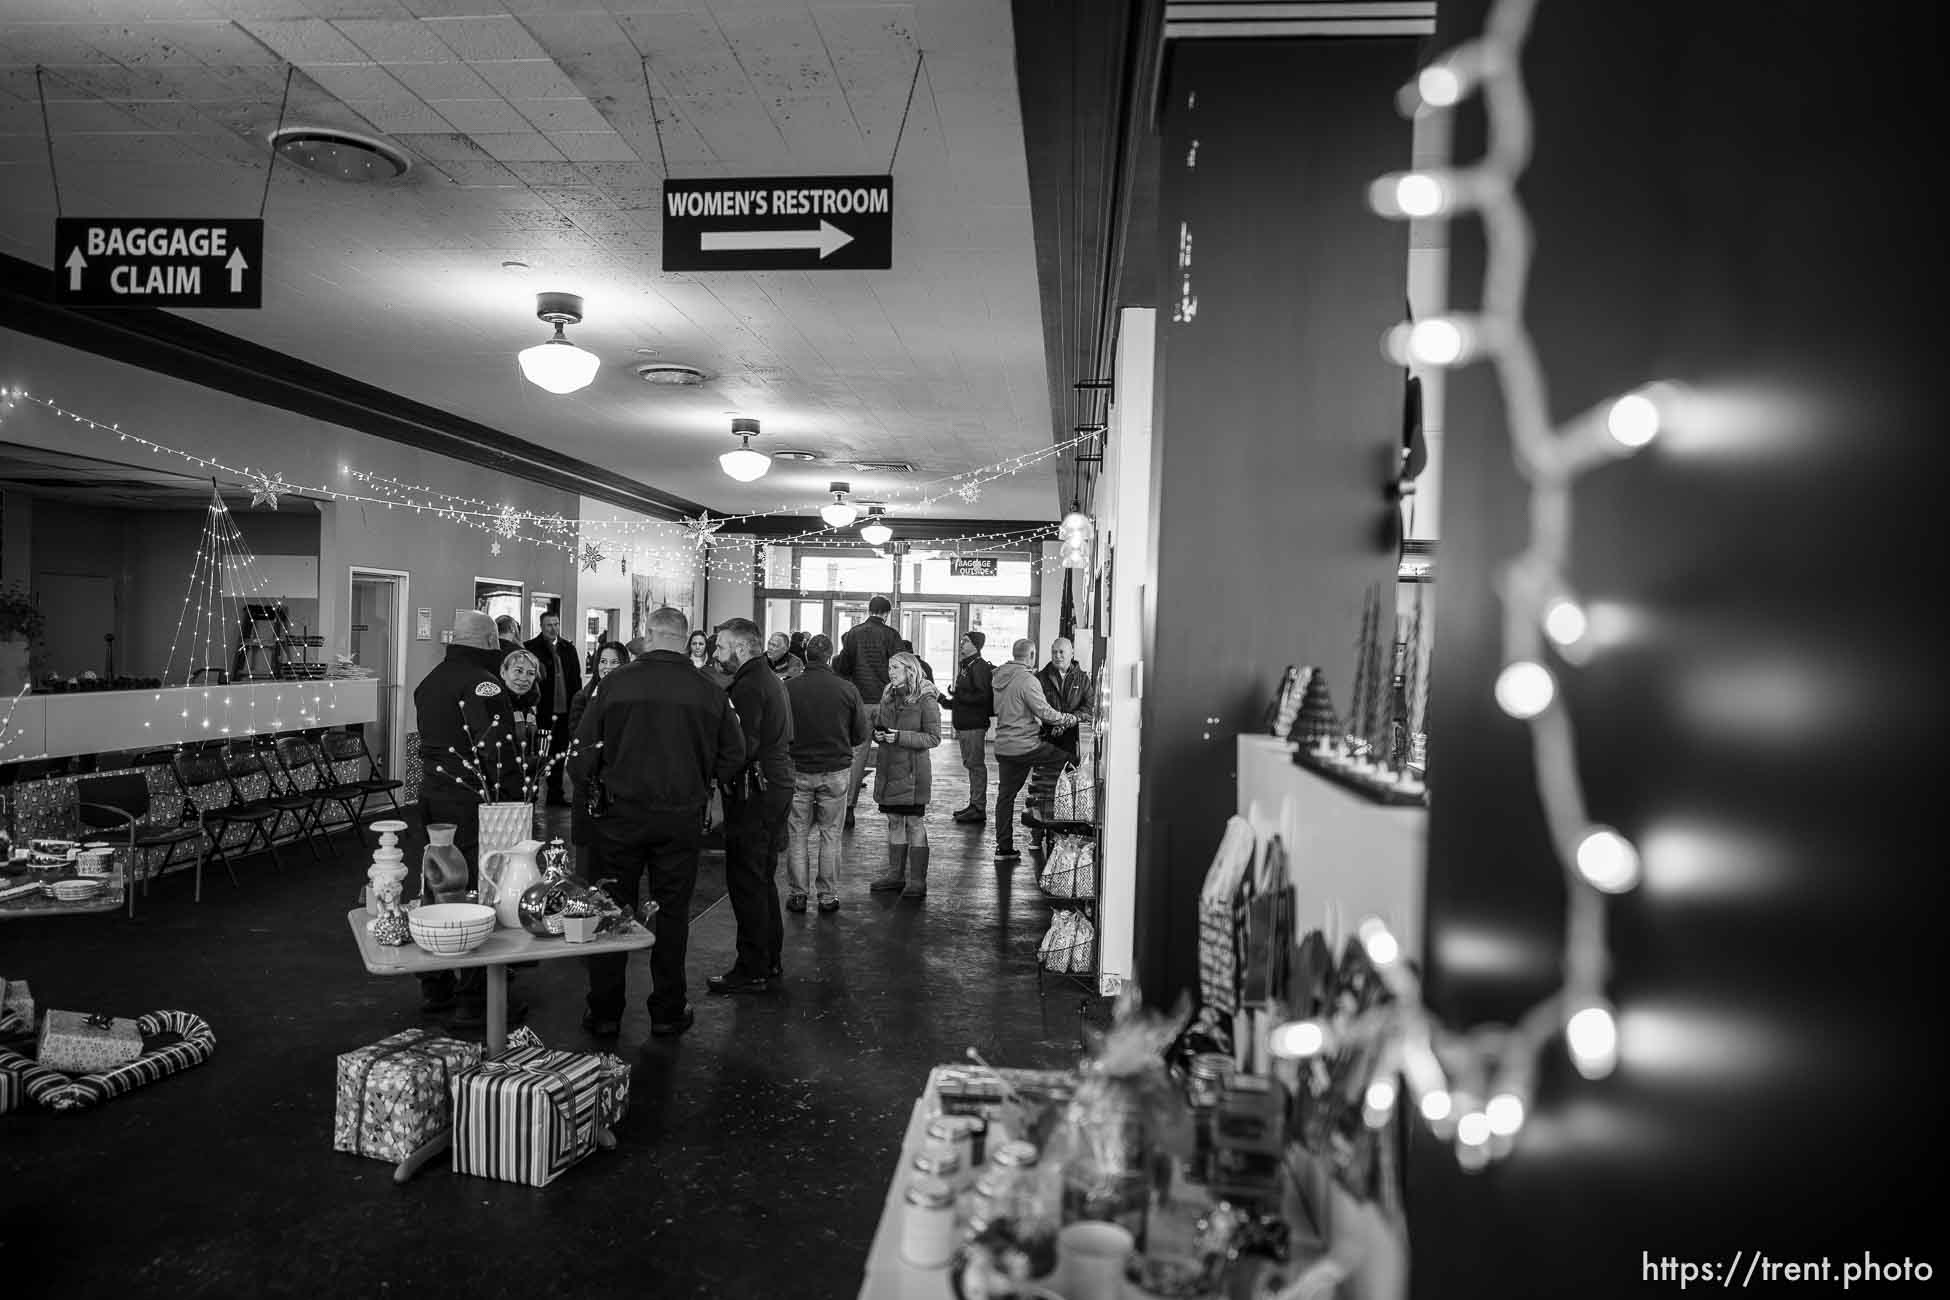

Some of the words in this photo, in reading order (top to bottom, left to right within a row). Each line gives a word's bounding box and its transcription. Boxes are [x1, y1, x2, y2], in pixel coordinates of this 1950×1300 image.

[668, 191, 768, 216] WOMEN’S
[773, 189, 888, 214] RESTROOM
[88, 228, 226, 256] BAGGAGE
[111, 266, 200, 294] CLAIM
